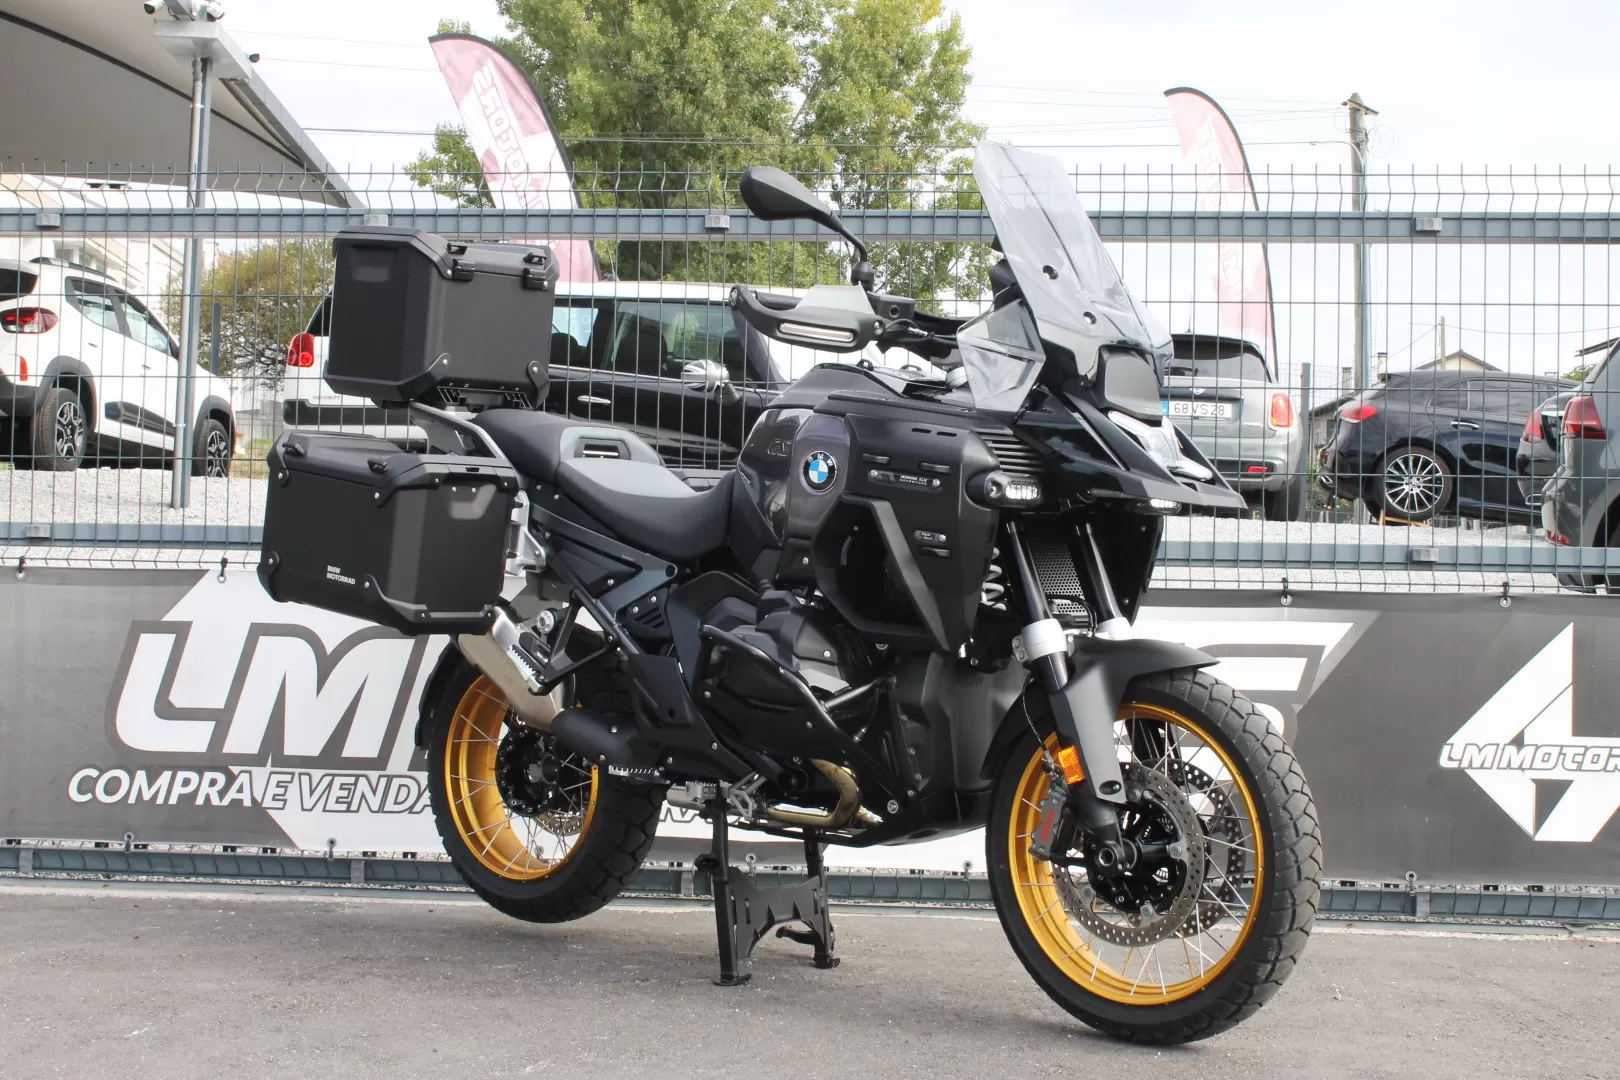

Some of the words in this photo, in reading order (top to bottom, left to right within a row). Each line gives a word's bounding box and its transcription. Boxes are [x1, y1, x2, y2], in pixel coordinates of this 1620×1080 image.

[327, 565, 341, 574] BMW
[326, 572, 356, 585] MOTORRAD
[67, 767, 254, 807] COMPRA
[261, 771, 296, 810] E
